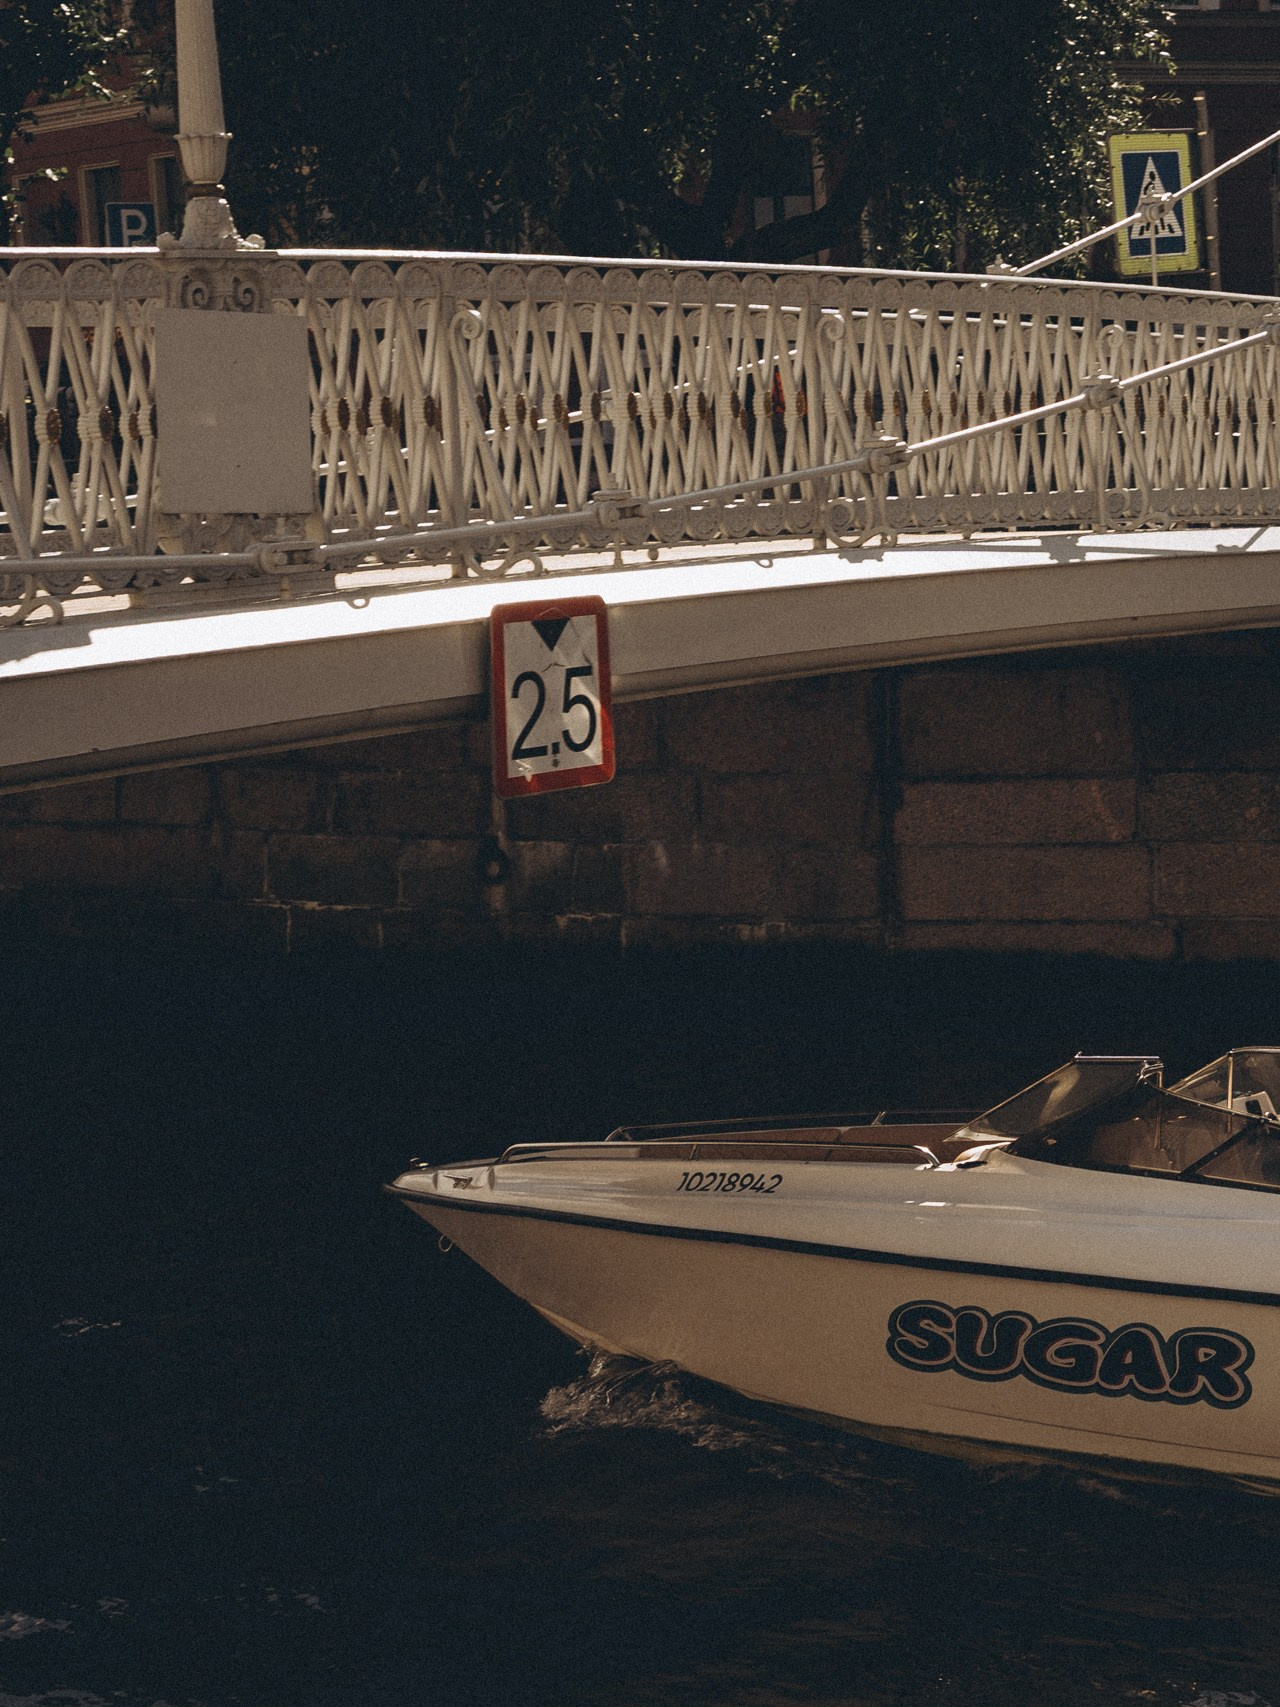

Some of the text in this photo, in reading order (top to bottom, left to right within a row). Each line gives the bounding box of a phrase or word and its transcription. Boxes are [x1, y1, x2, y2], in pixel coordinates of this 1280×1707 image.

[121, 208, 148, 247] P
[676, 1171, 783, 1194] 10218942
[886, 1300, 1255, 1410] SUGAR
